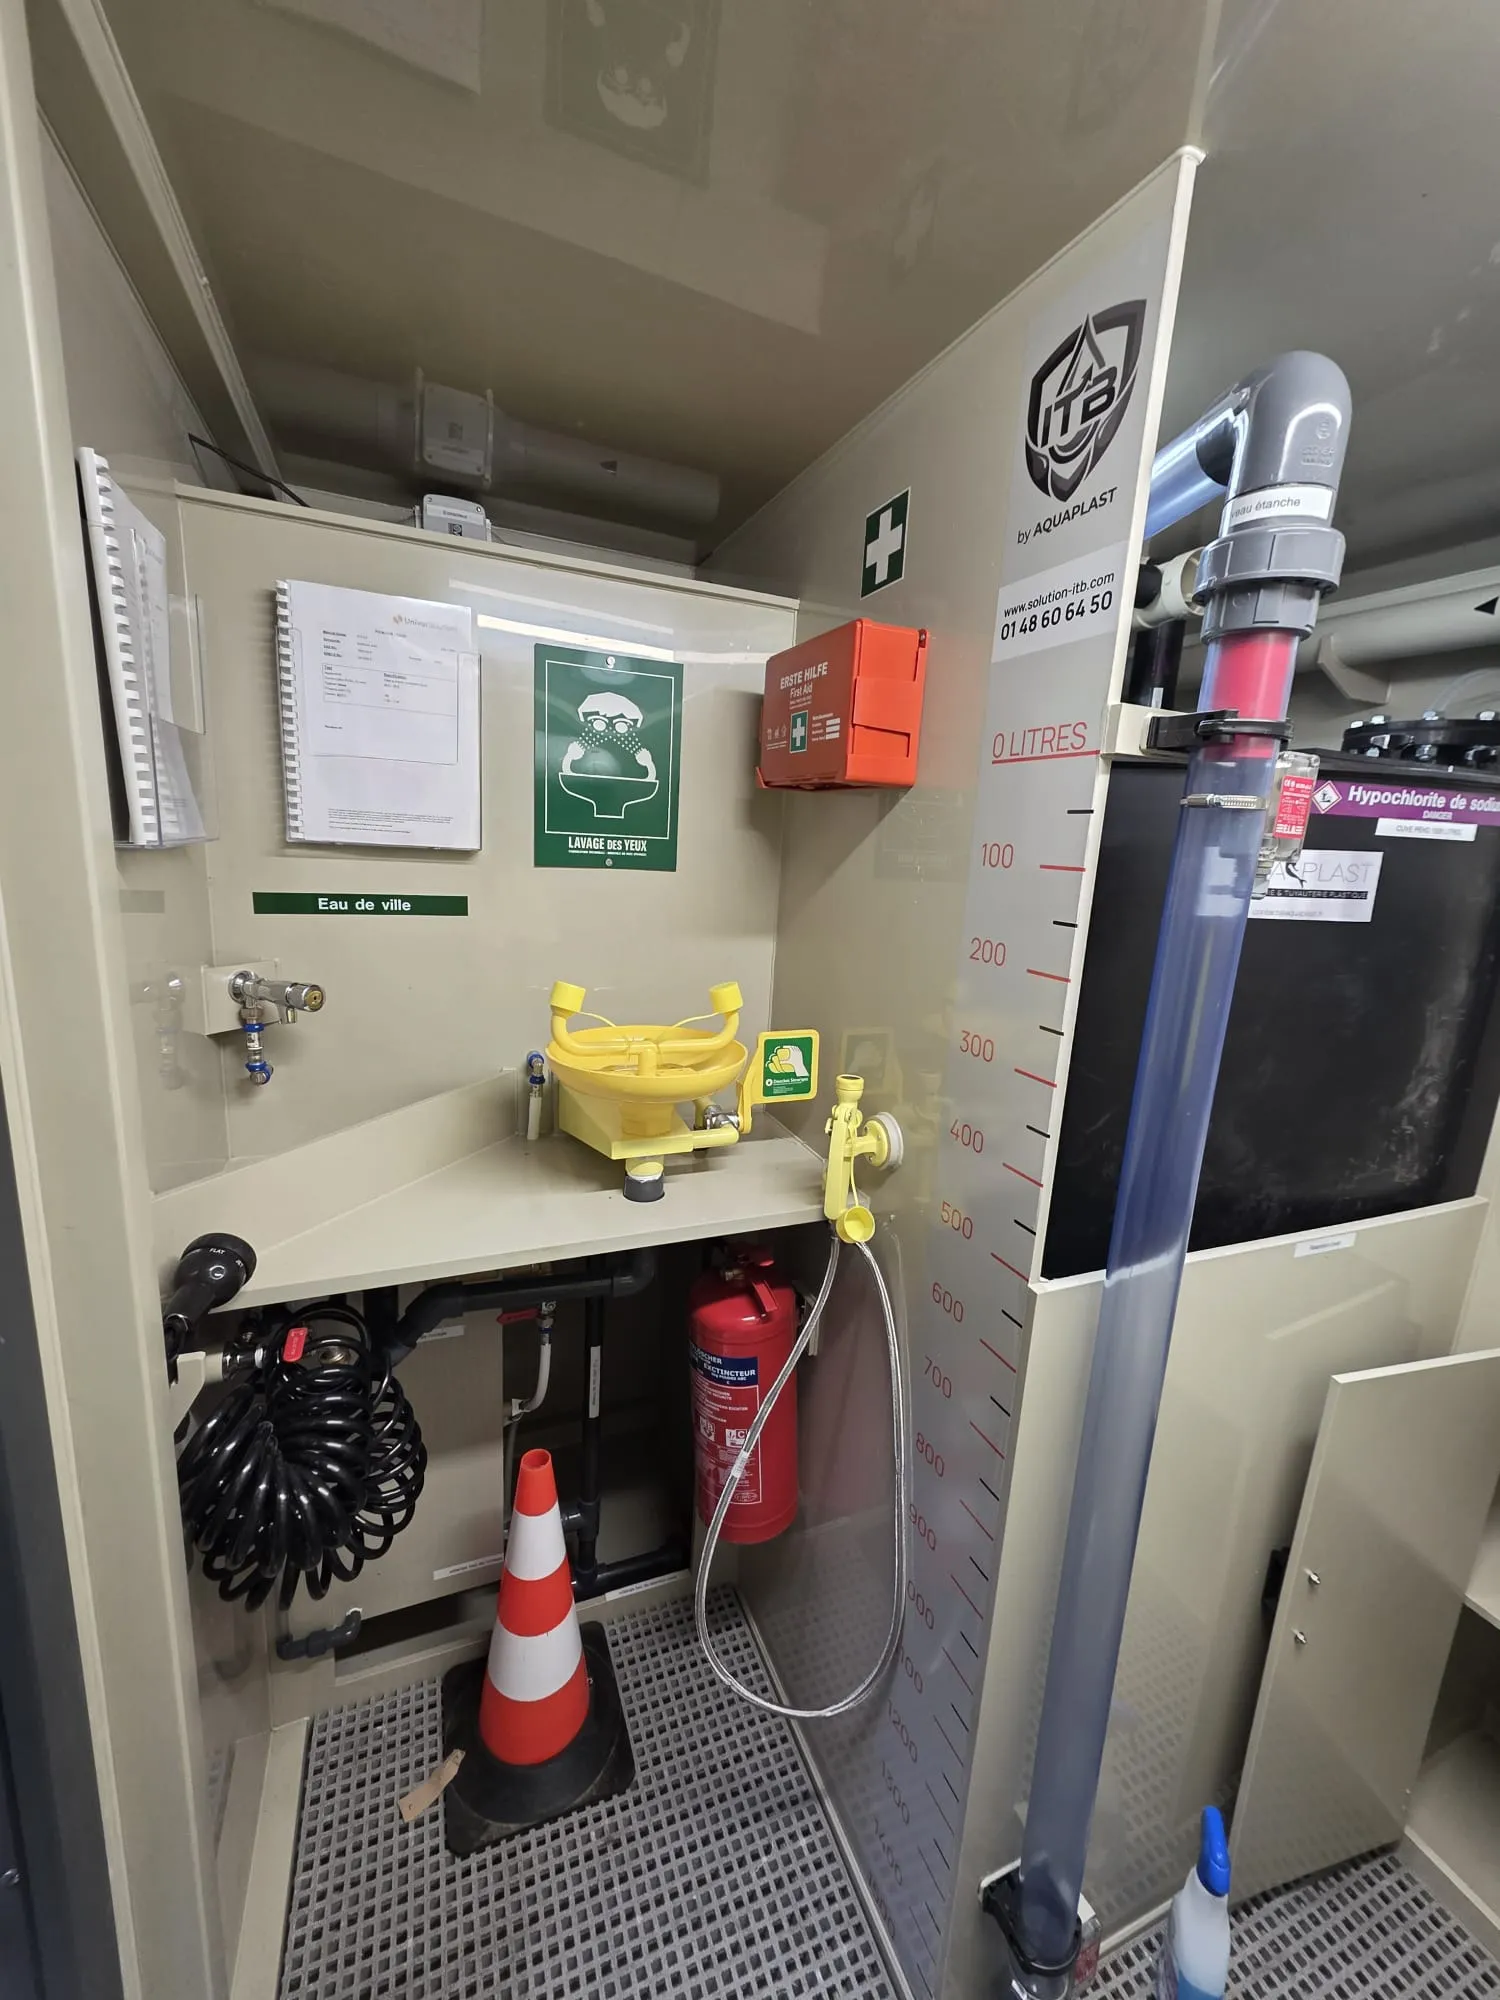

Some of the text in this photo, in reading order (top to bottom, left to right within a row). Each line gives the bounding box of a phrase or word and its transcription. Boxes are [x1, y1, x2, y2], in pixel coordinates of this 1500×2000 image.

[1041, 364, 1118, 449] ITB
[1017, 486, 1118, 544] by AQUAPLAST
[1255, 497, 1301, 511] étanche
[1004, 572, 1115, 618] www.solution-itb.com
[1001, 590, 1113, 640] 01 48 60 64 50
[780, 661, 829, 690] ERSTE HILFE
[790, 681, 813, 698] First Aid
[992, 721, 1088, 759] 0 LITRES
[1348, 785, 1446, 809] Hypochlorite
[1450, 793, 1467, 810] de
[568, 836, 648, 852] LAVAGE DES YEUX
[981, 842, 1014, 869] 100
[317, 897, 412, 911] Eau de ville
[969, 937, 1007, 967] 200
[959, 1030, 995, 1063] 300
[950, 1118, 984, 1154] 400
[940, 1200, 974, 1240] 500
[932, 1281, 964, 1323] 600
[923, 1355, 953, 1400] 700
[915, 1431, 945, 1478] 800
[908, 1502, 937, 1551] 900
[907, 1580, 934, 1630] 000
[888, 1698, 918, 1763] 1200
